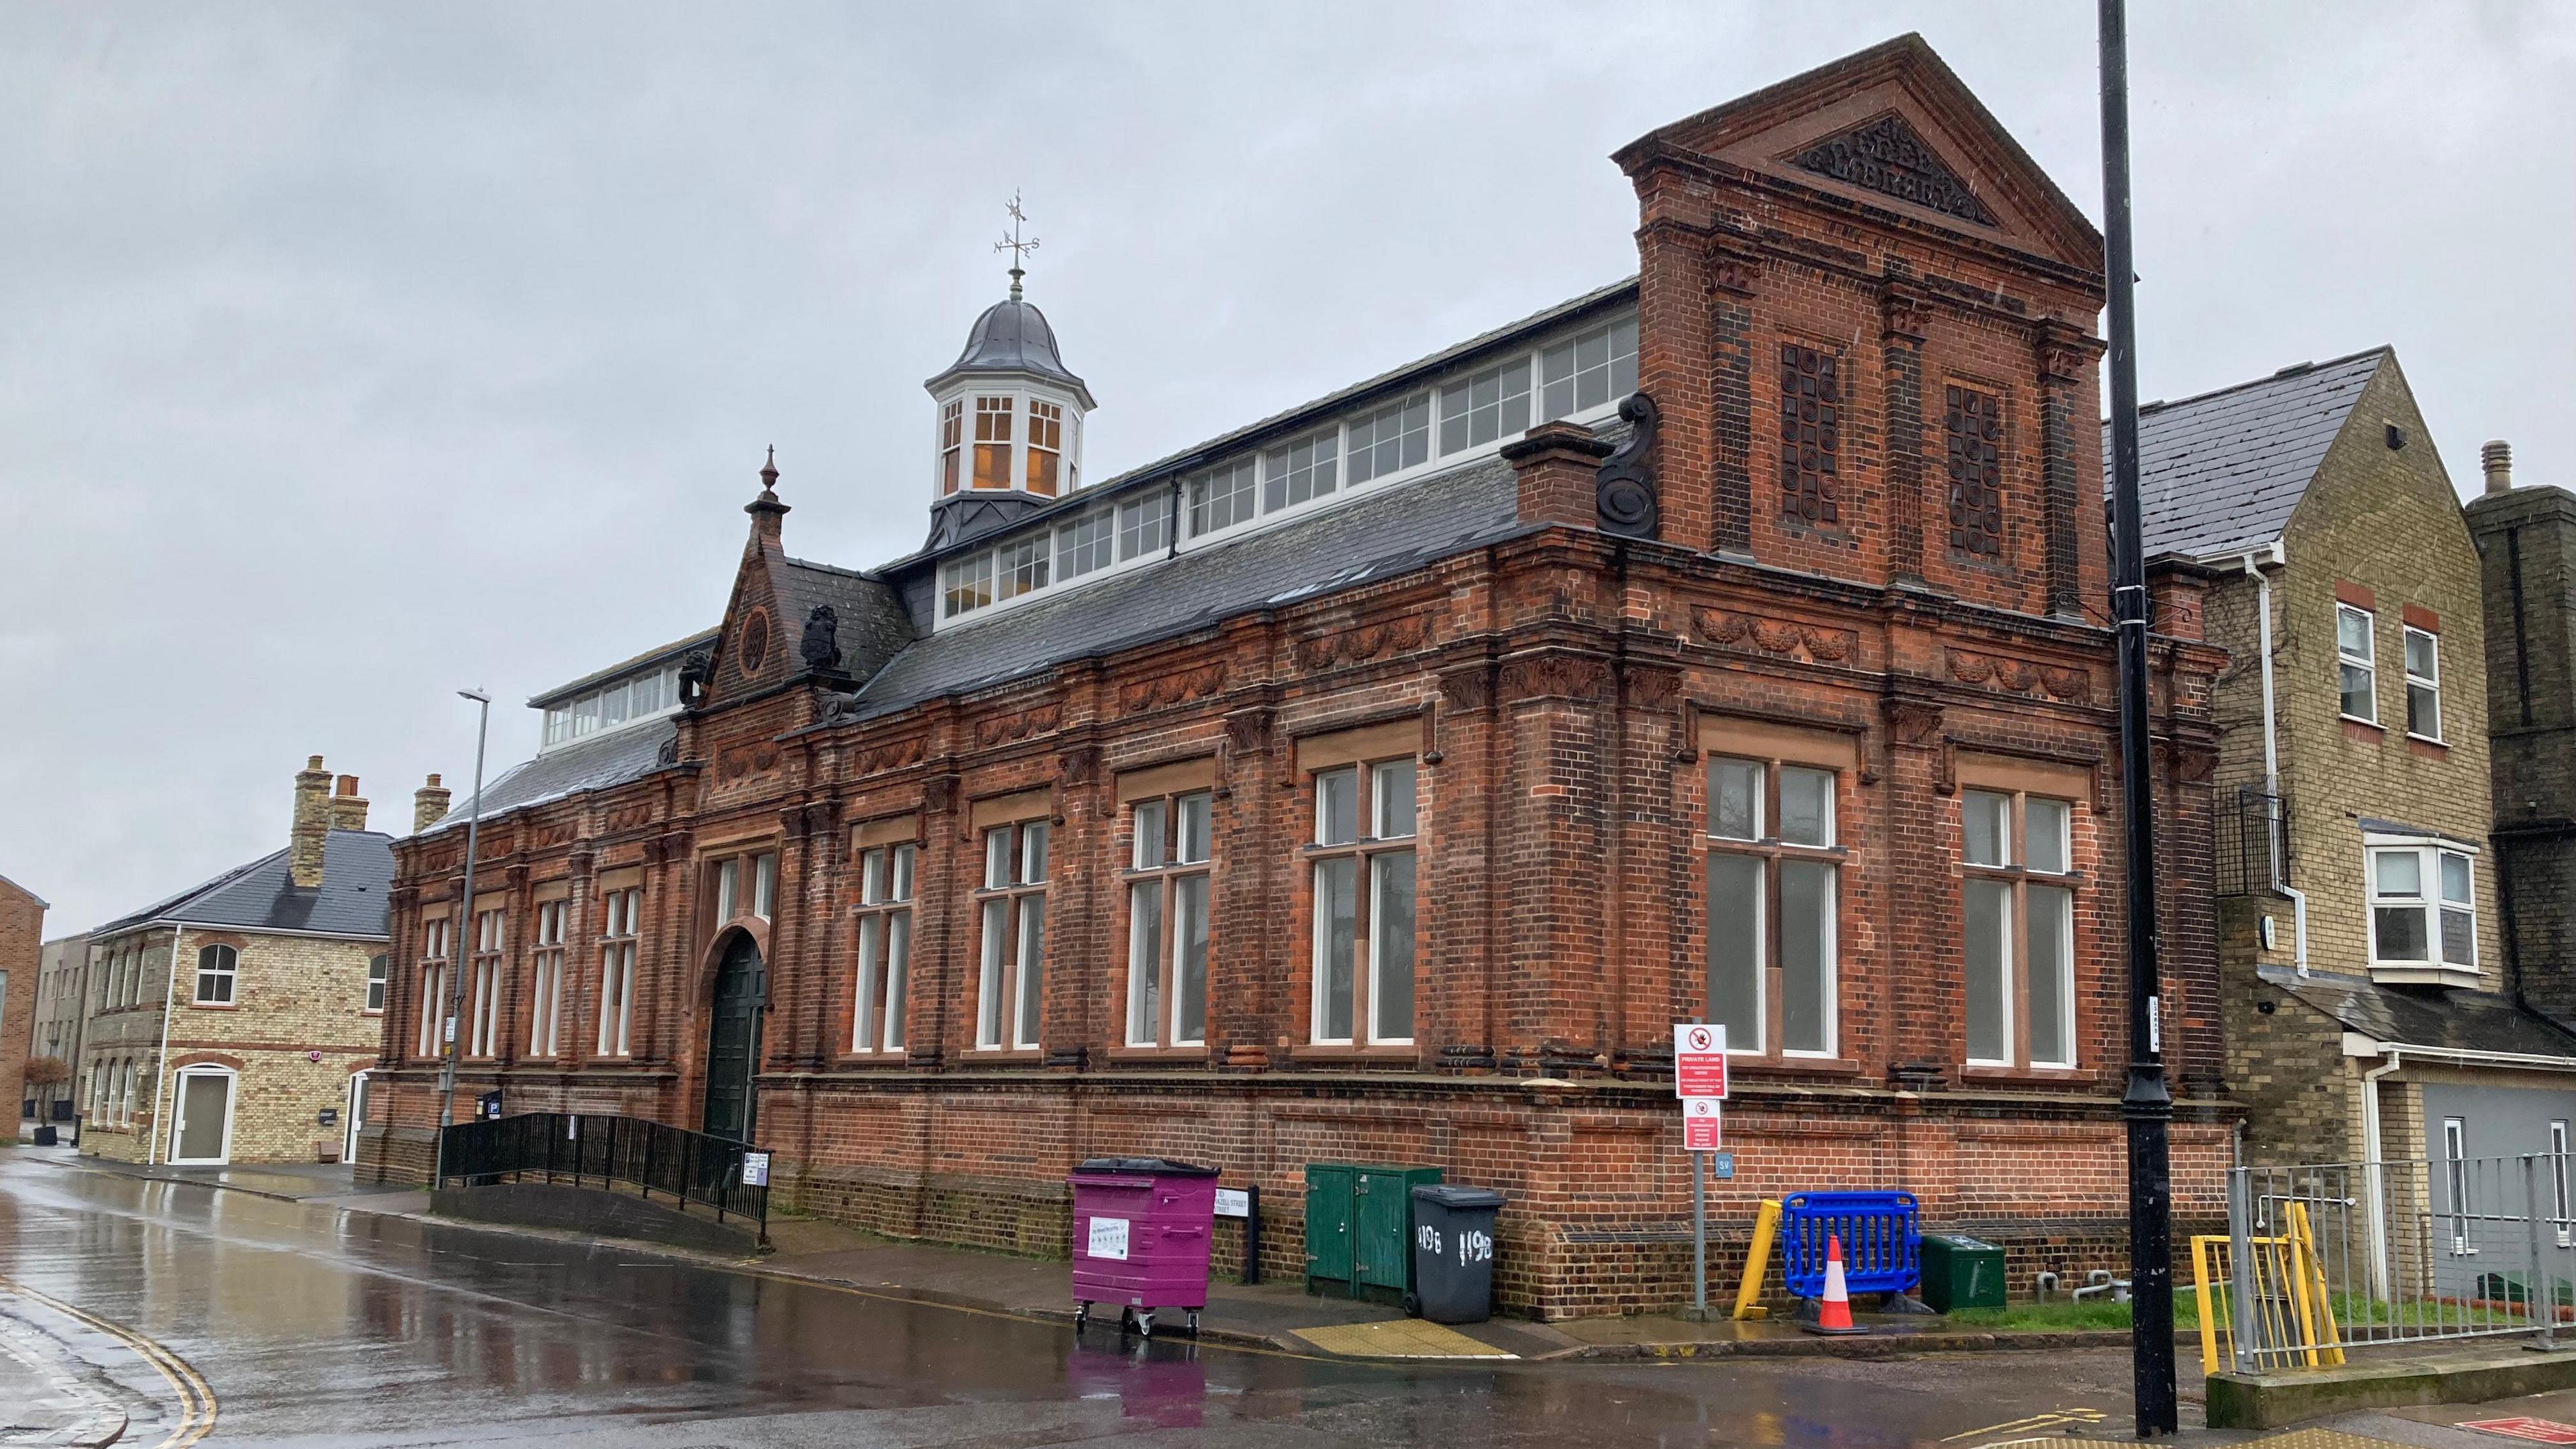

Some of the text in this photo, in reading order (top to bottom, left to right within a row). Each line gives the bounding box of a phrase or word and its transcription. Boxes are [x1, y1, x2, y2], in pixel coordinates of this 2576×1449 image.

[994, 241, 1002, 254] N
[1031, 237, 1040, 249] S
[490, 1104, 497, 1112] P
[1719, 1161, 1729, 1169] SV
[1230, 1199, 1246, 1208] STREET
